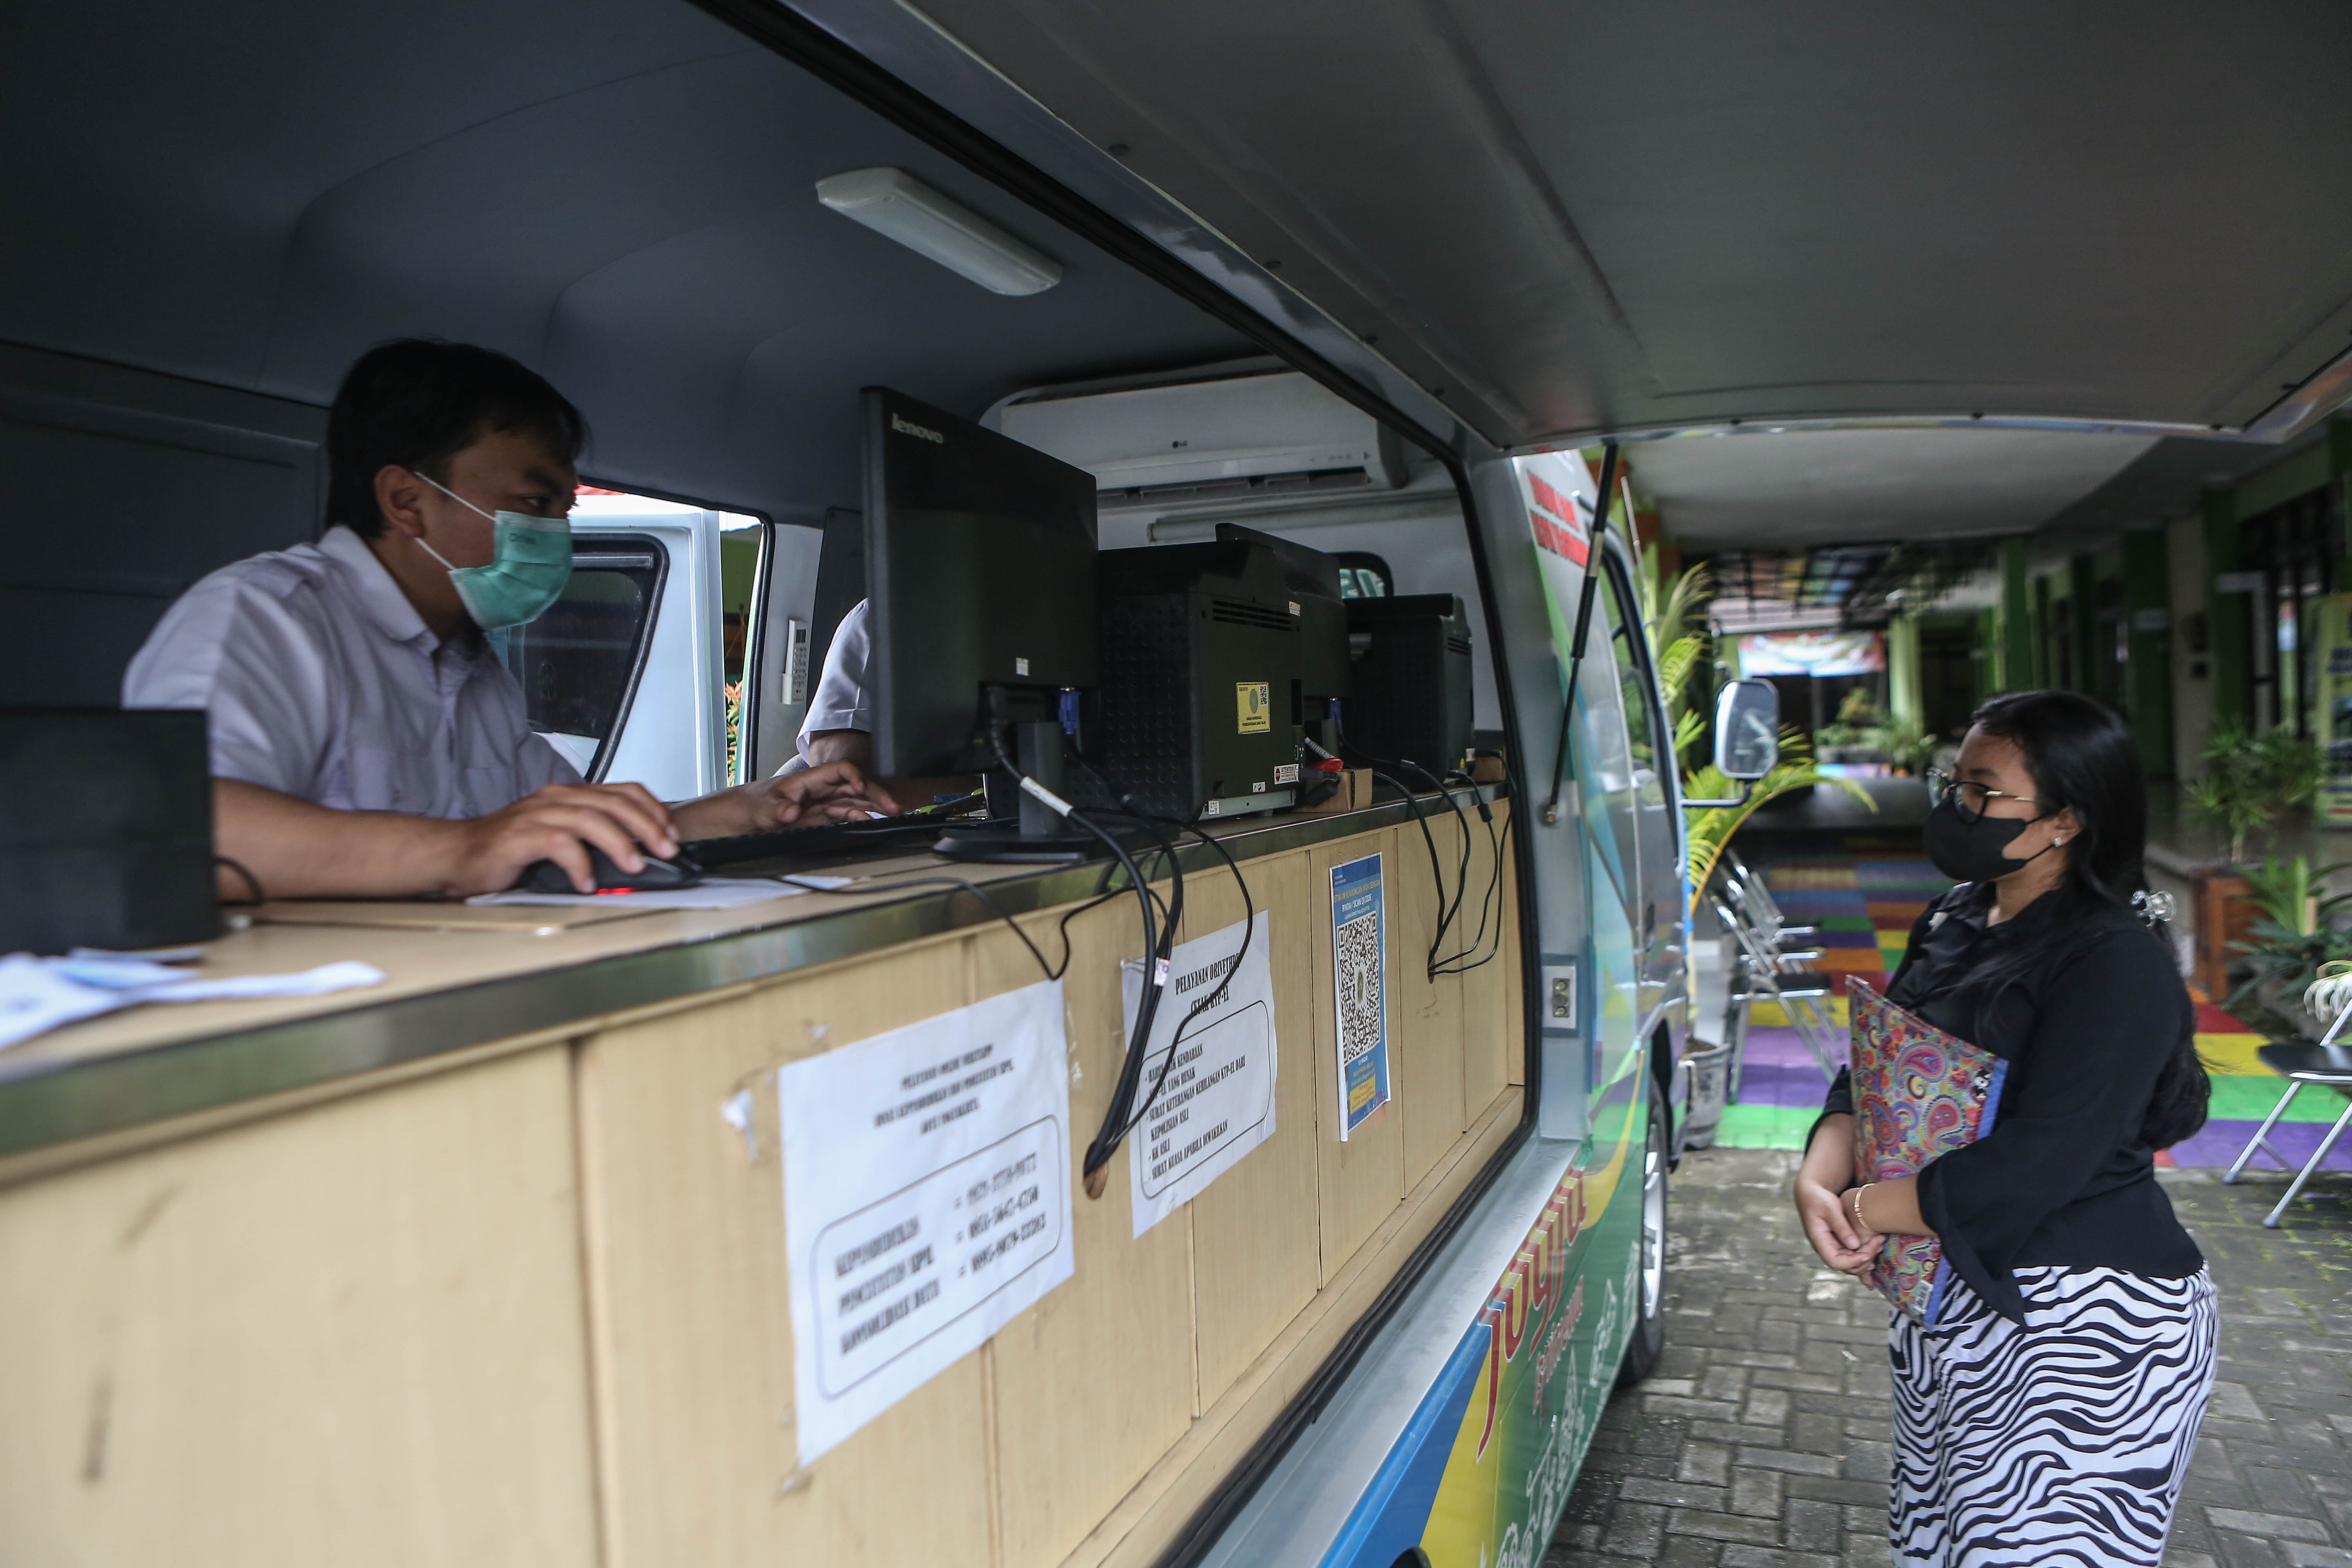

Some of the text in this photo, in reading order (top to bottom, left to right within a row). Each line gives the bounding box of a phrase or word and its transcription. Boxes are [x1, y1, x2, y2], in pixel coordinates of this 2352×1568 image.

[892, 412, 944, 444] lenovo
[1176, 966, 1209, 995] PELAYANAN
[1177, 1043, 1203, 1067] KENDARAAN
[1166, 1085, 1195, 1112] KETERANGAN
[1221, 1060, 1235, 1080] KTP-EL
[1236, 1055, 1245, 1070] DARI
[1167, 1074, 1180, 1092] YANG
[1181, 1066, 1196, 1085] RUSAK
[1184, 1138, 1202, 1159] APABILA
